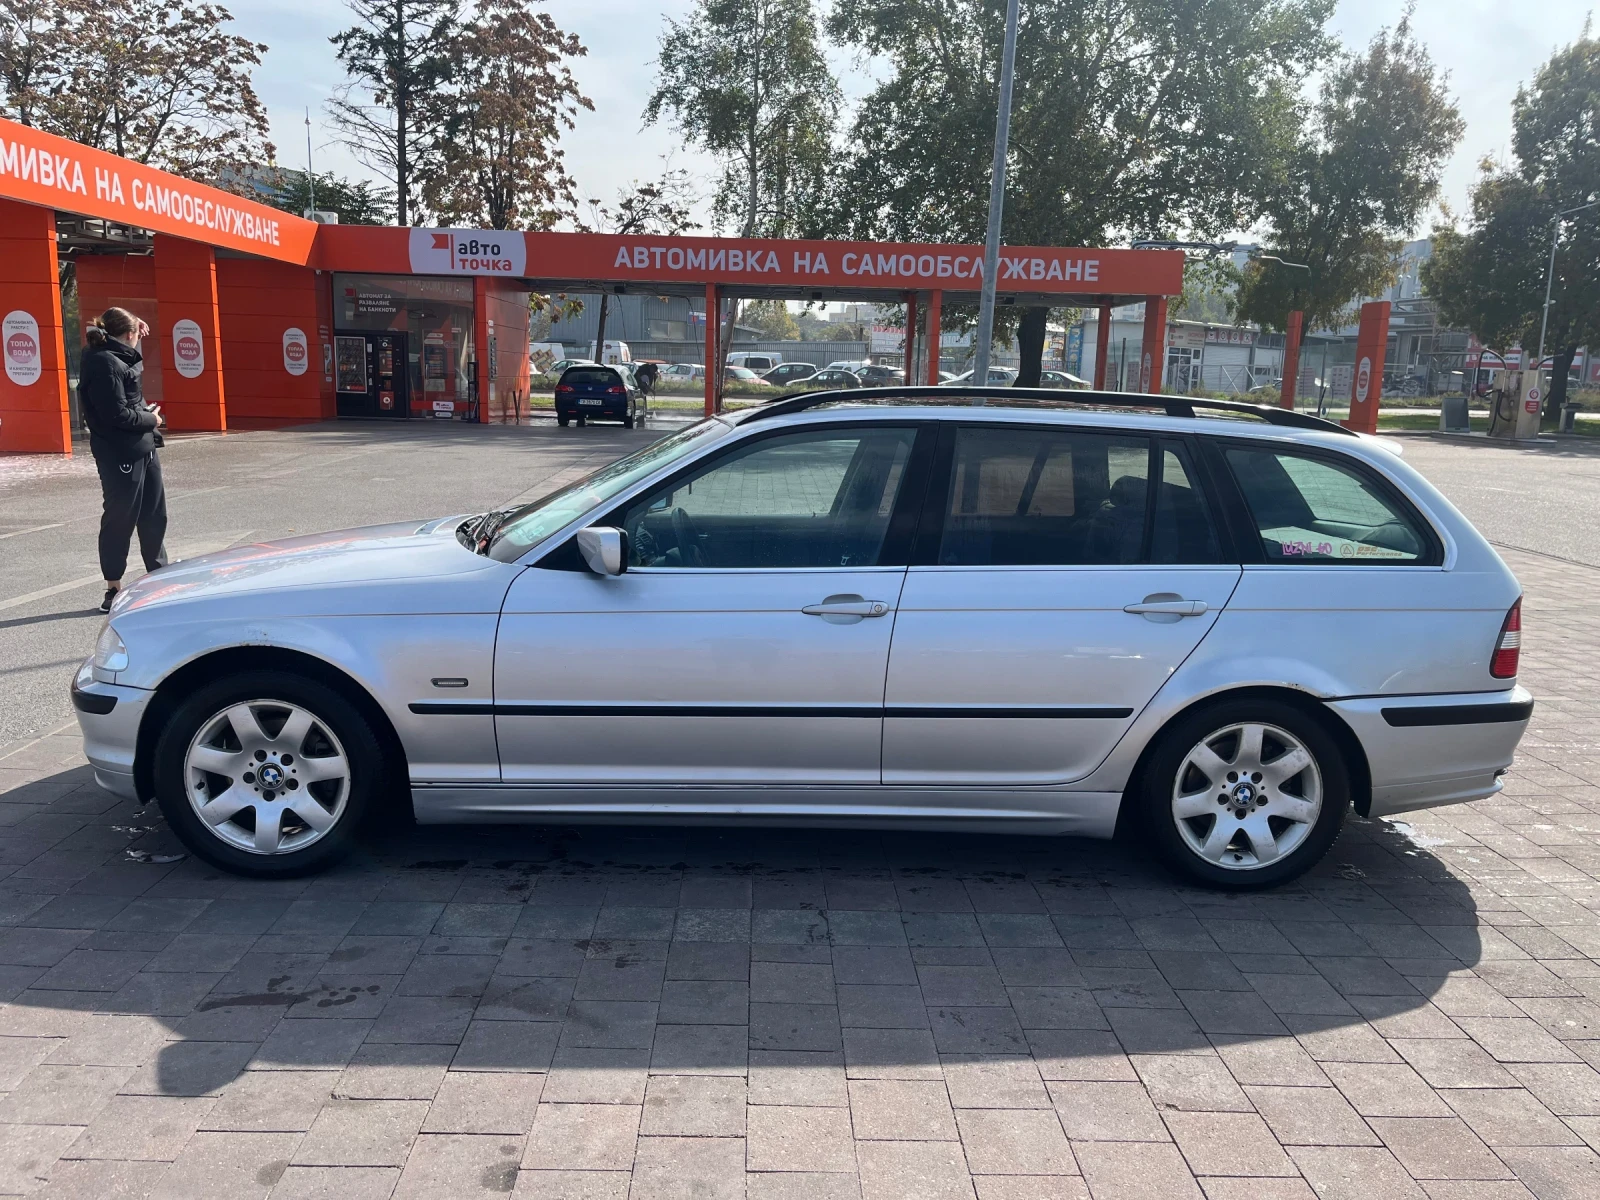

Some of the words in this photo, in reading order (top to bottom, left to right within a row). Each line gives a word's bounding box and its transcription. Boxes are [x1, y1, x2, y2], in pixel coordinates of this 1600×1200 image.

[0, 137, 87, 196] МИВКА
[95, 166, 125, 205] НА
[132, 178, 280, 247] САМООБСЛУЖВАНЕ
[459, 258, 512, 271] точка
[614, 246, 781, 273] АВТОМИВКА
[793, 251, 830, 274] НА
[842, 253, 1100, 281] САМООБСЛЖВАНЕ
